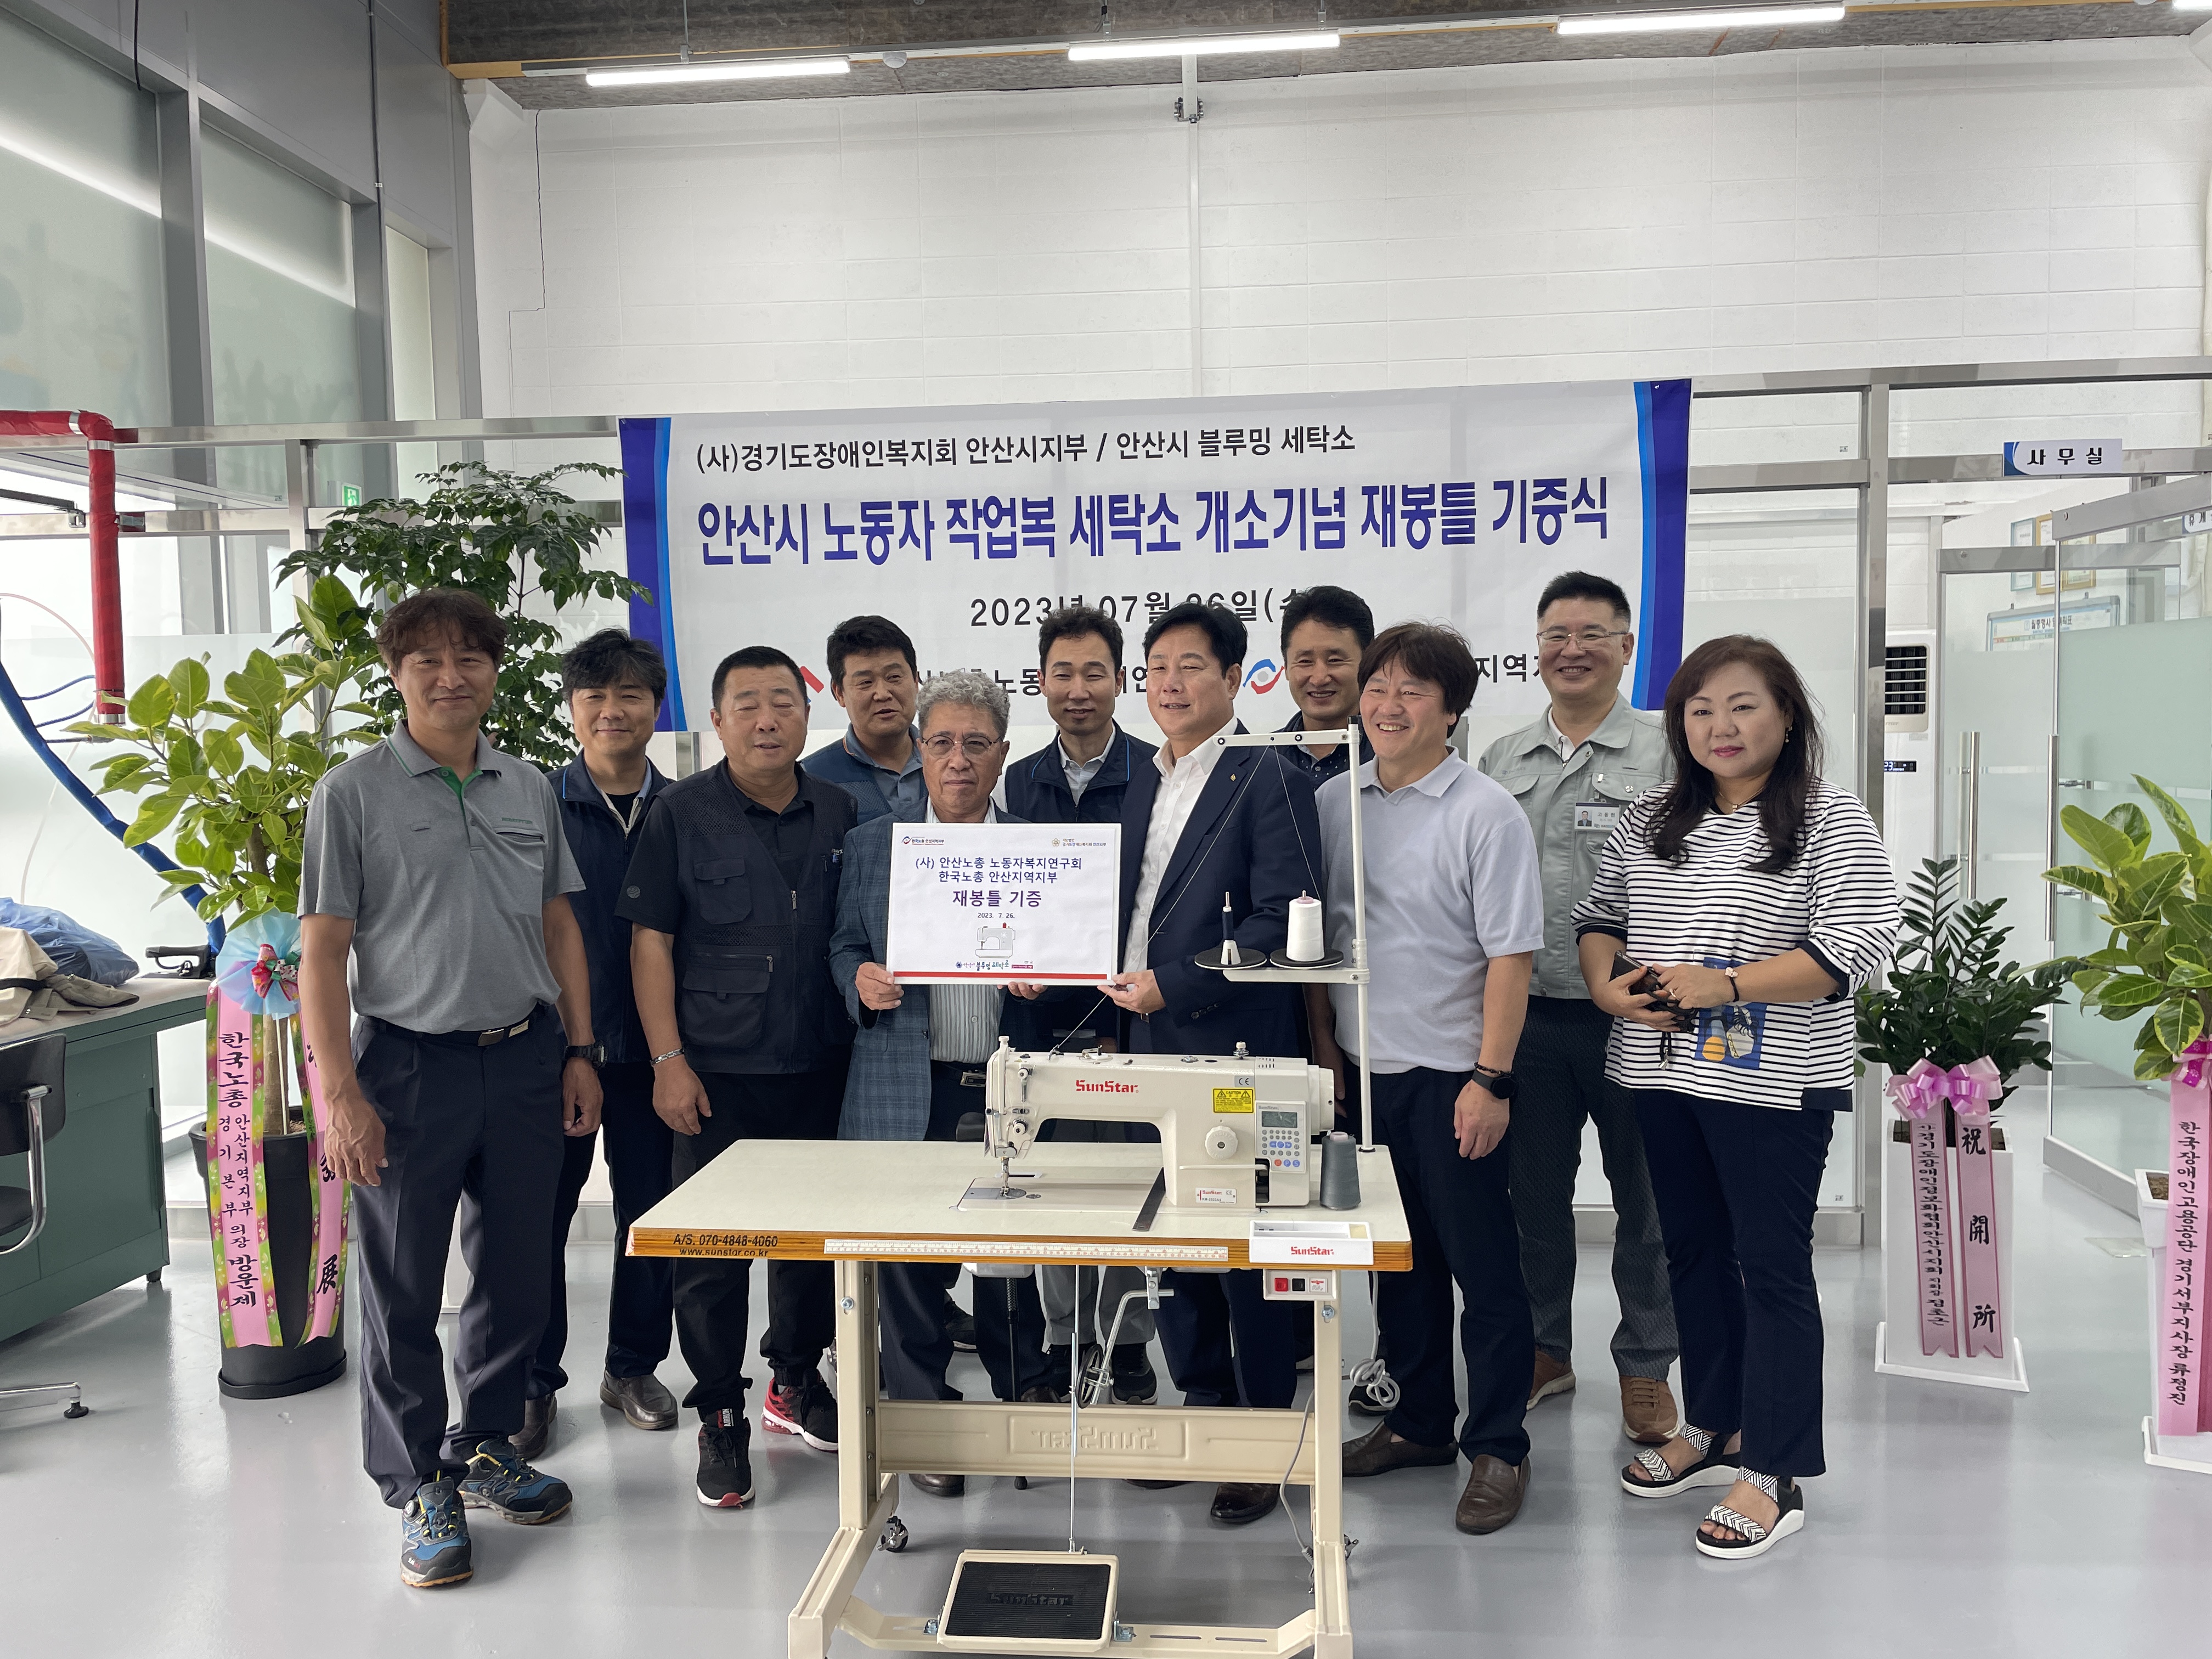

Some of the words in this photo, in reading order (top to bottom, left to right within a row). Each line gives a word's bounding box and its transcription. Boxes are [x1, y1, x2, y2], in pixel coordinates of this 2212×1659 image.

[697, 439, 957, 473] (사)경기도장애인복지회
[967, 434, 1087, 466] 안산시지부
[1097, 433, 1107, 462] /
[1117, 430, 1188, 460] 안산시
[1198, 428, 1271, 458] 블루밍
[1281, 425, 1356, 454] 세탁소
[698, 501, 810, 565] 안산시
[823, 499, 935, 566] 노동자
[946, 495, 1056, 560] 작업복
[1069, 492, 1182, 557] 세탁소
[1196, 486, 1346, 553] 개소기념
[1361, 482, 1477, 550] 재봉틀
[1492, 476, 1608, 546] 기증식
[916, 857, 934, 869] (사)
[940, 856, 985, 869] 안산노총
[989, 857, 1082, 870] 노동자복지연구회
[939, 871, 984, 883] 한국노총
[989, 871, 1058, 883] 안산지역지부
[952, 889, 1002, 907] 재봉틀
[1009, 890, 1042, 907] 기증
[218, 1031, 250, 1108] 한국노총
[1076, 1080, 1139, 1093] SunStar
[234, 1114, 253, 1217] 안산지역지부
[2175, 1121, 2201, 1252] 한국장애인고용공단
[673, 1234, 695, 1245] A/S.
[699, 1235, 778, 1247] 070-4848-4060
[679, 1248, 769, 1257] www.sunstar.co.kr
[1291, 1246, 1333, 1255] SunStar
[227, 1254, 259, 1308] 방운제
[2169, 1258, 2194, 1359] 경기서부지사장
